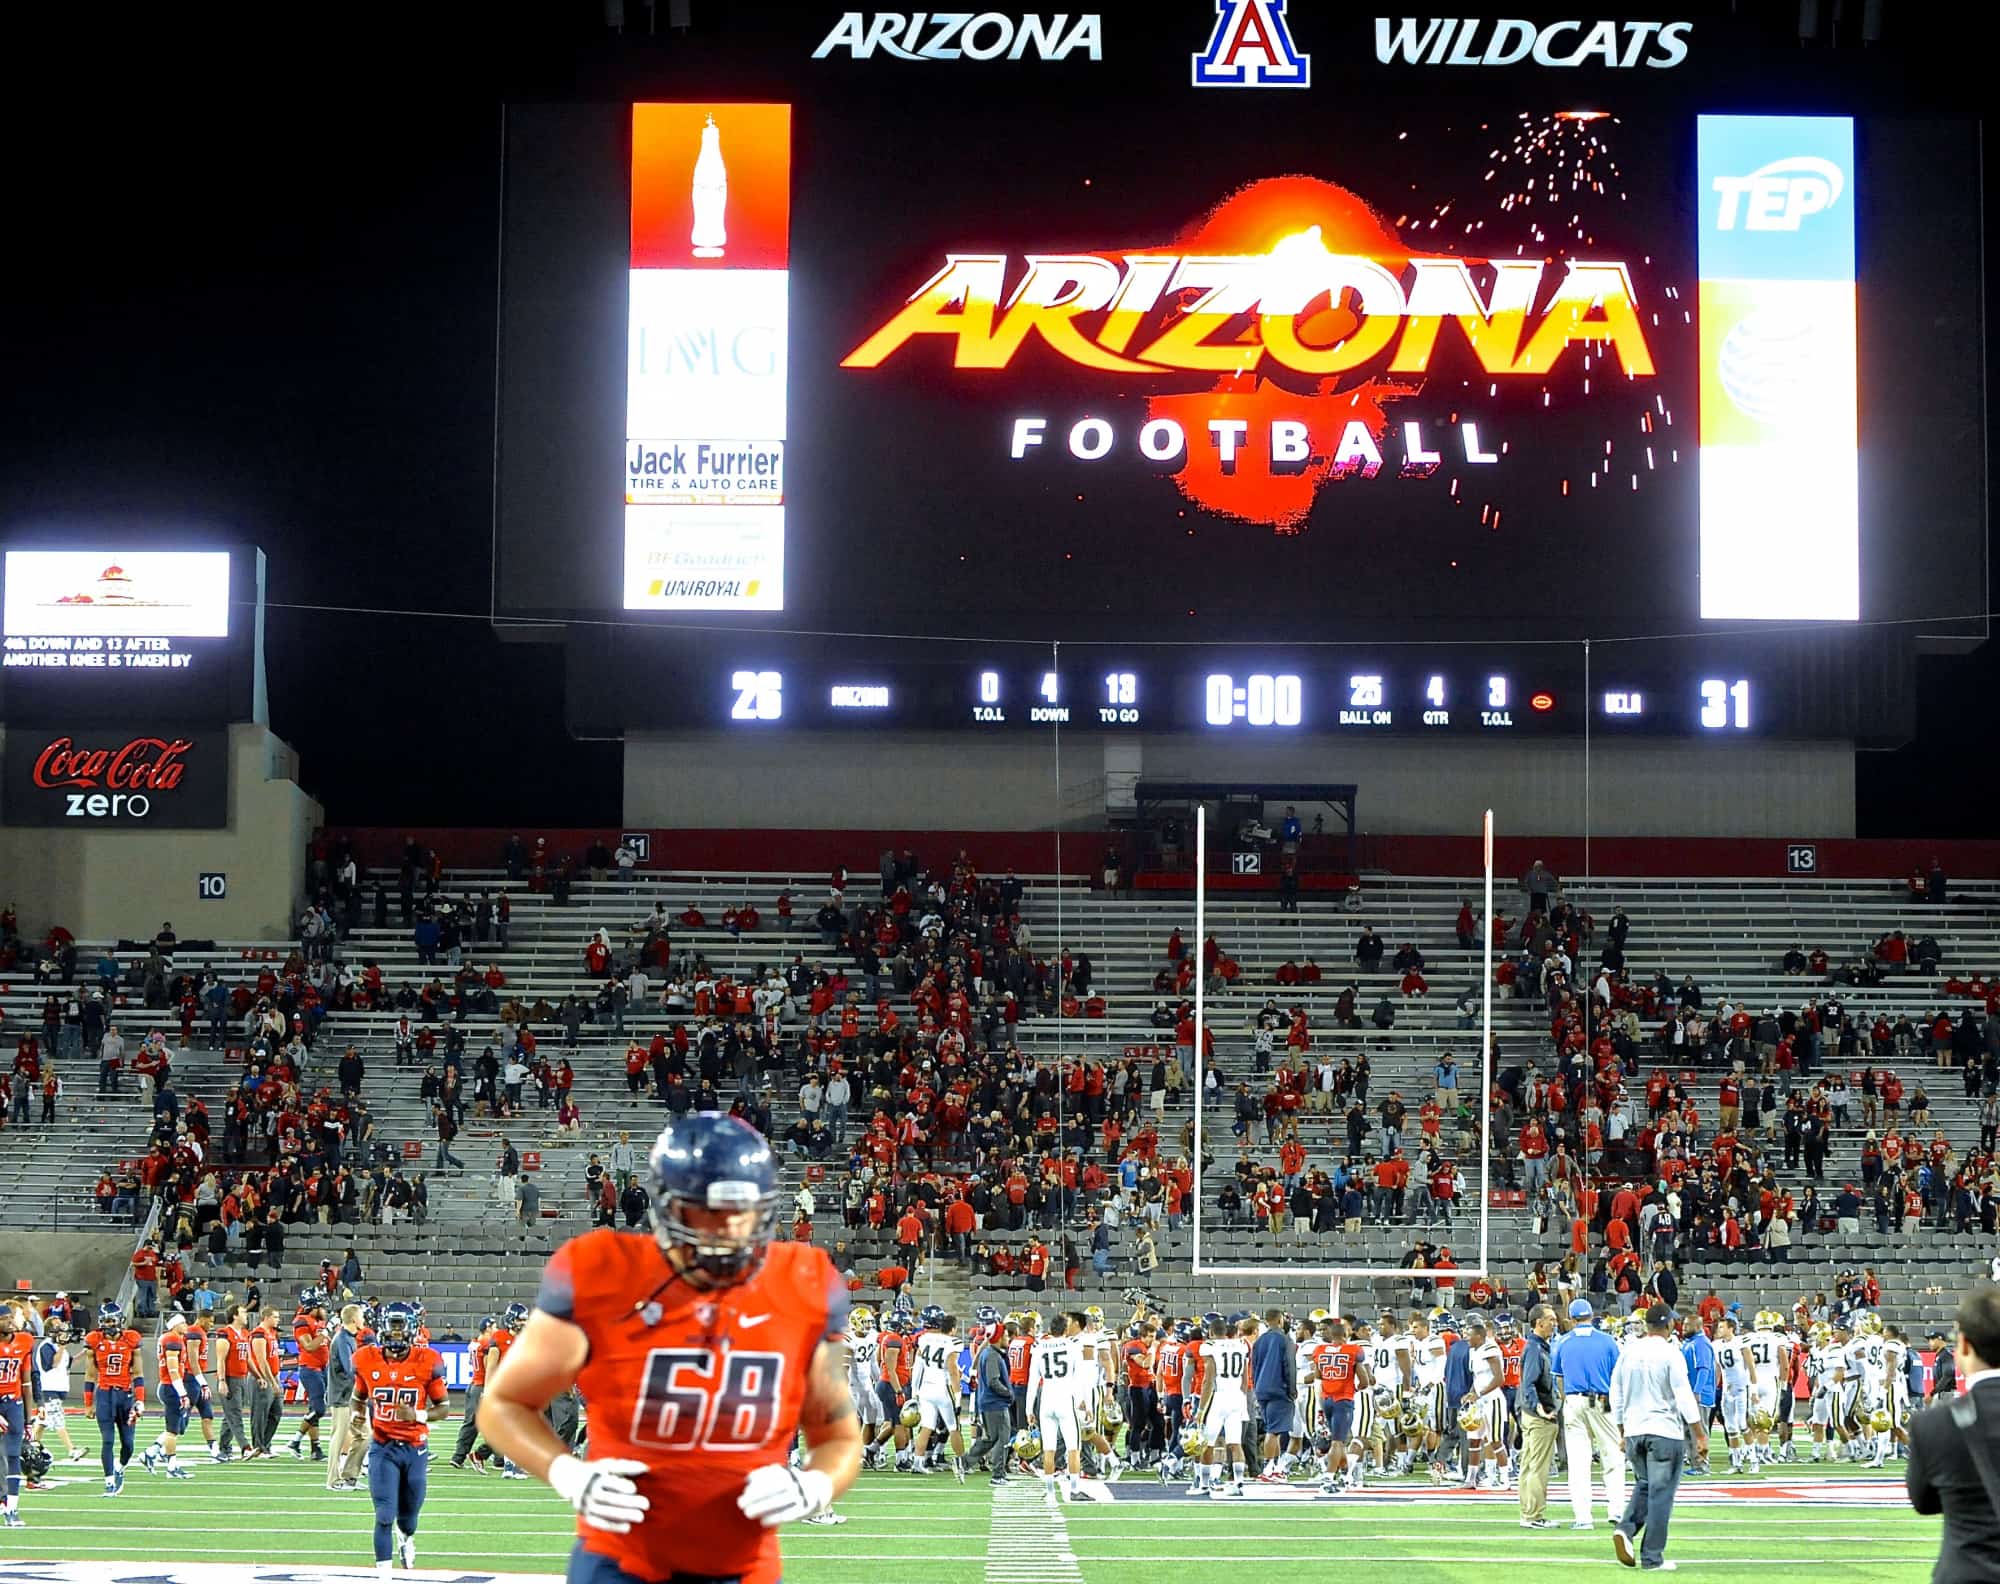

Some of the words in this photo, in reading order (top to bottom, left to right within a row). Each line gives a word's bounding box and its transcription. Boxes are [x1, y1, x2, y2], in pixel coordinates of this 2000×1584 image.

[811, 12, 1103, 60] ARIZONA
[1191, 0, 1311, 88] A
[1374, 18, 1693, 68] WILDCATS
[1711, 175, 1831, 232] TEP
[840, 253, 1656, 376] ARIZONA
[639, 326, 776, 376] IMG
[1010, 417, 1500, 465] FOOTBALL
[629, 444, 687, 475] Jack
[698, 444, 780, 475] Furrier
[632, 478, 665, 489] TIRE
[671, 478, 681, 489] &
[689, 478, 732, 490] AUTO
[737, 479, 779, 490] CARE
[664, 580, 742, 597] UNIROYAL
[28, 637, 72, 650] DOWN
[73, 637, 103, 650] AND
[106, 638, 123, 650] 13
[125, 638, 170, 650] AFTER
[3, 653, 68, 667] ANOTHER
[69, 653, 106, 667] KNEE
[108, 654, 122, 667] IS
[124, 654, 170, 667] TAKEN
[171, 654, 193, 667] BY
[731, 671, 782, 720] 26
[981, 672, 999, 702] 0
[1041, 673, 1058, 703] 4
[1206, 674, 1301, 726] 0:00
[1427, 676, 1444, 706] 4
[1031, 708, 1069, 722] DOWN
[1099, 709, 1118, 722] TO
[1119, 709, 1139, 722] GO
[1701, 679, 1749, 728] 31
[1339, 711, 1372, 724] BALL
[1373, 711, 1392, 725] ON
[1423, 711, 1449, 725] QTR
[33, 737, 193, 790] Coca-Cola
[66, 794, 150, 817] zero
[1234, 854, 1259, 873] 12
[1790, 849, 1814, 869] 13
[200, 877, 225, 896] 10
[106, 1353, 123, 1376] 5
[921, 1344, 945, 1370] 44
[1041, 1350, 1069, 1380] 15
[1220, 1352, 1243, 1379] 10
[1317, 1353, 1350, 1380] 25
[1718, 1348, 1735, 1371] 19
[1750, 1343, 1770, 1365] 51
[629, 1347, 786, 1452] 68
